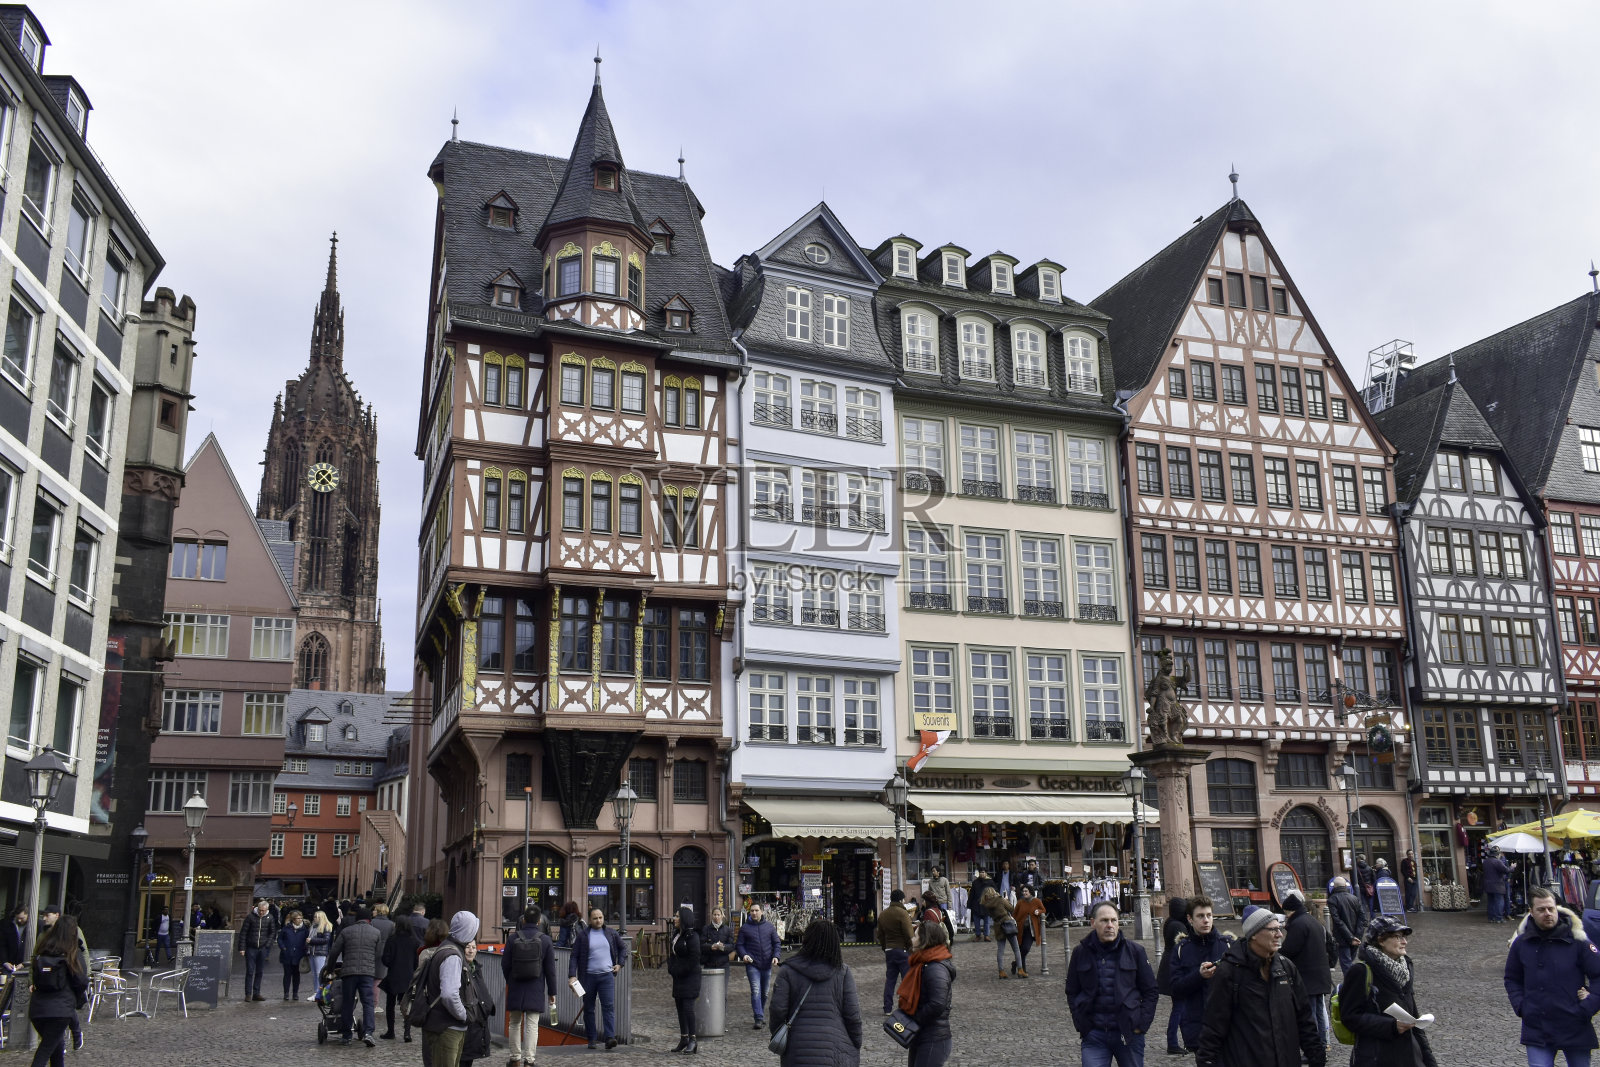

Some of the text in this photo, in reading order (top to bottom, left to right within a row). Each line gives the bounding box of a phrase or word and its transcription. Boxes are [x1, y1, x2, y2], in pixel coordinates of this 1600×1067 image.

[922, 713, 950, 727] Souvenirs
[908, 772, 985, 790] ouvenirs
[1038, 775, 1123, 792] Geschenke
